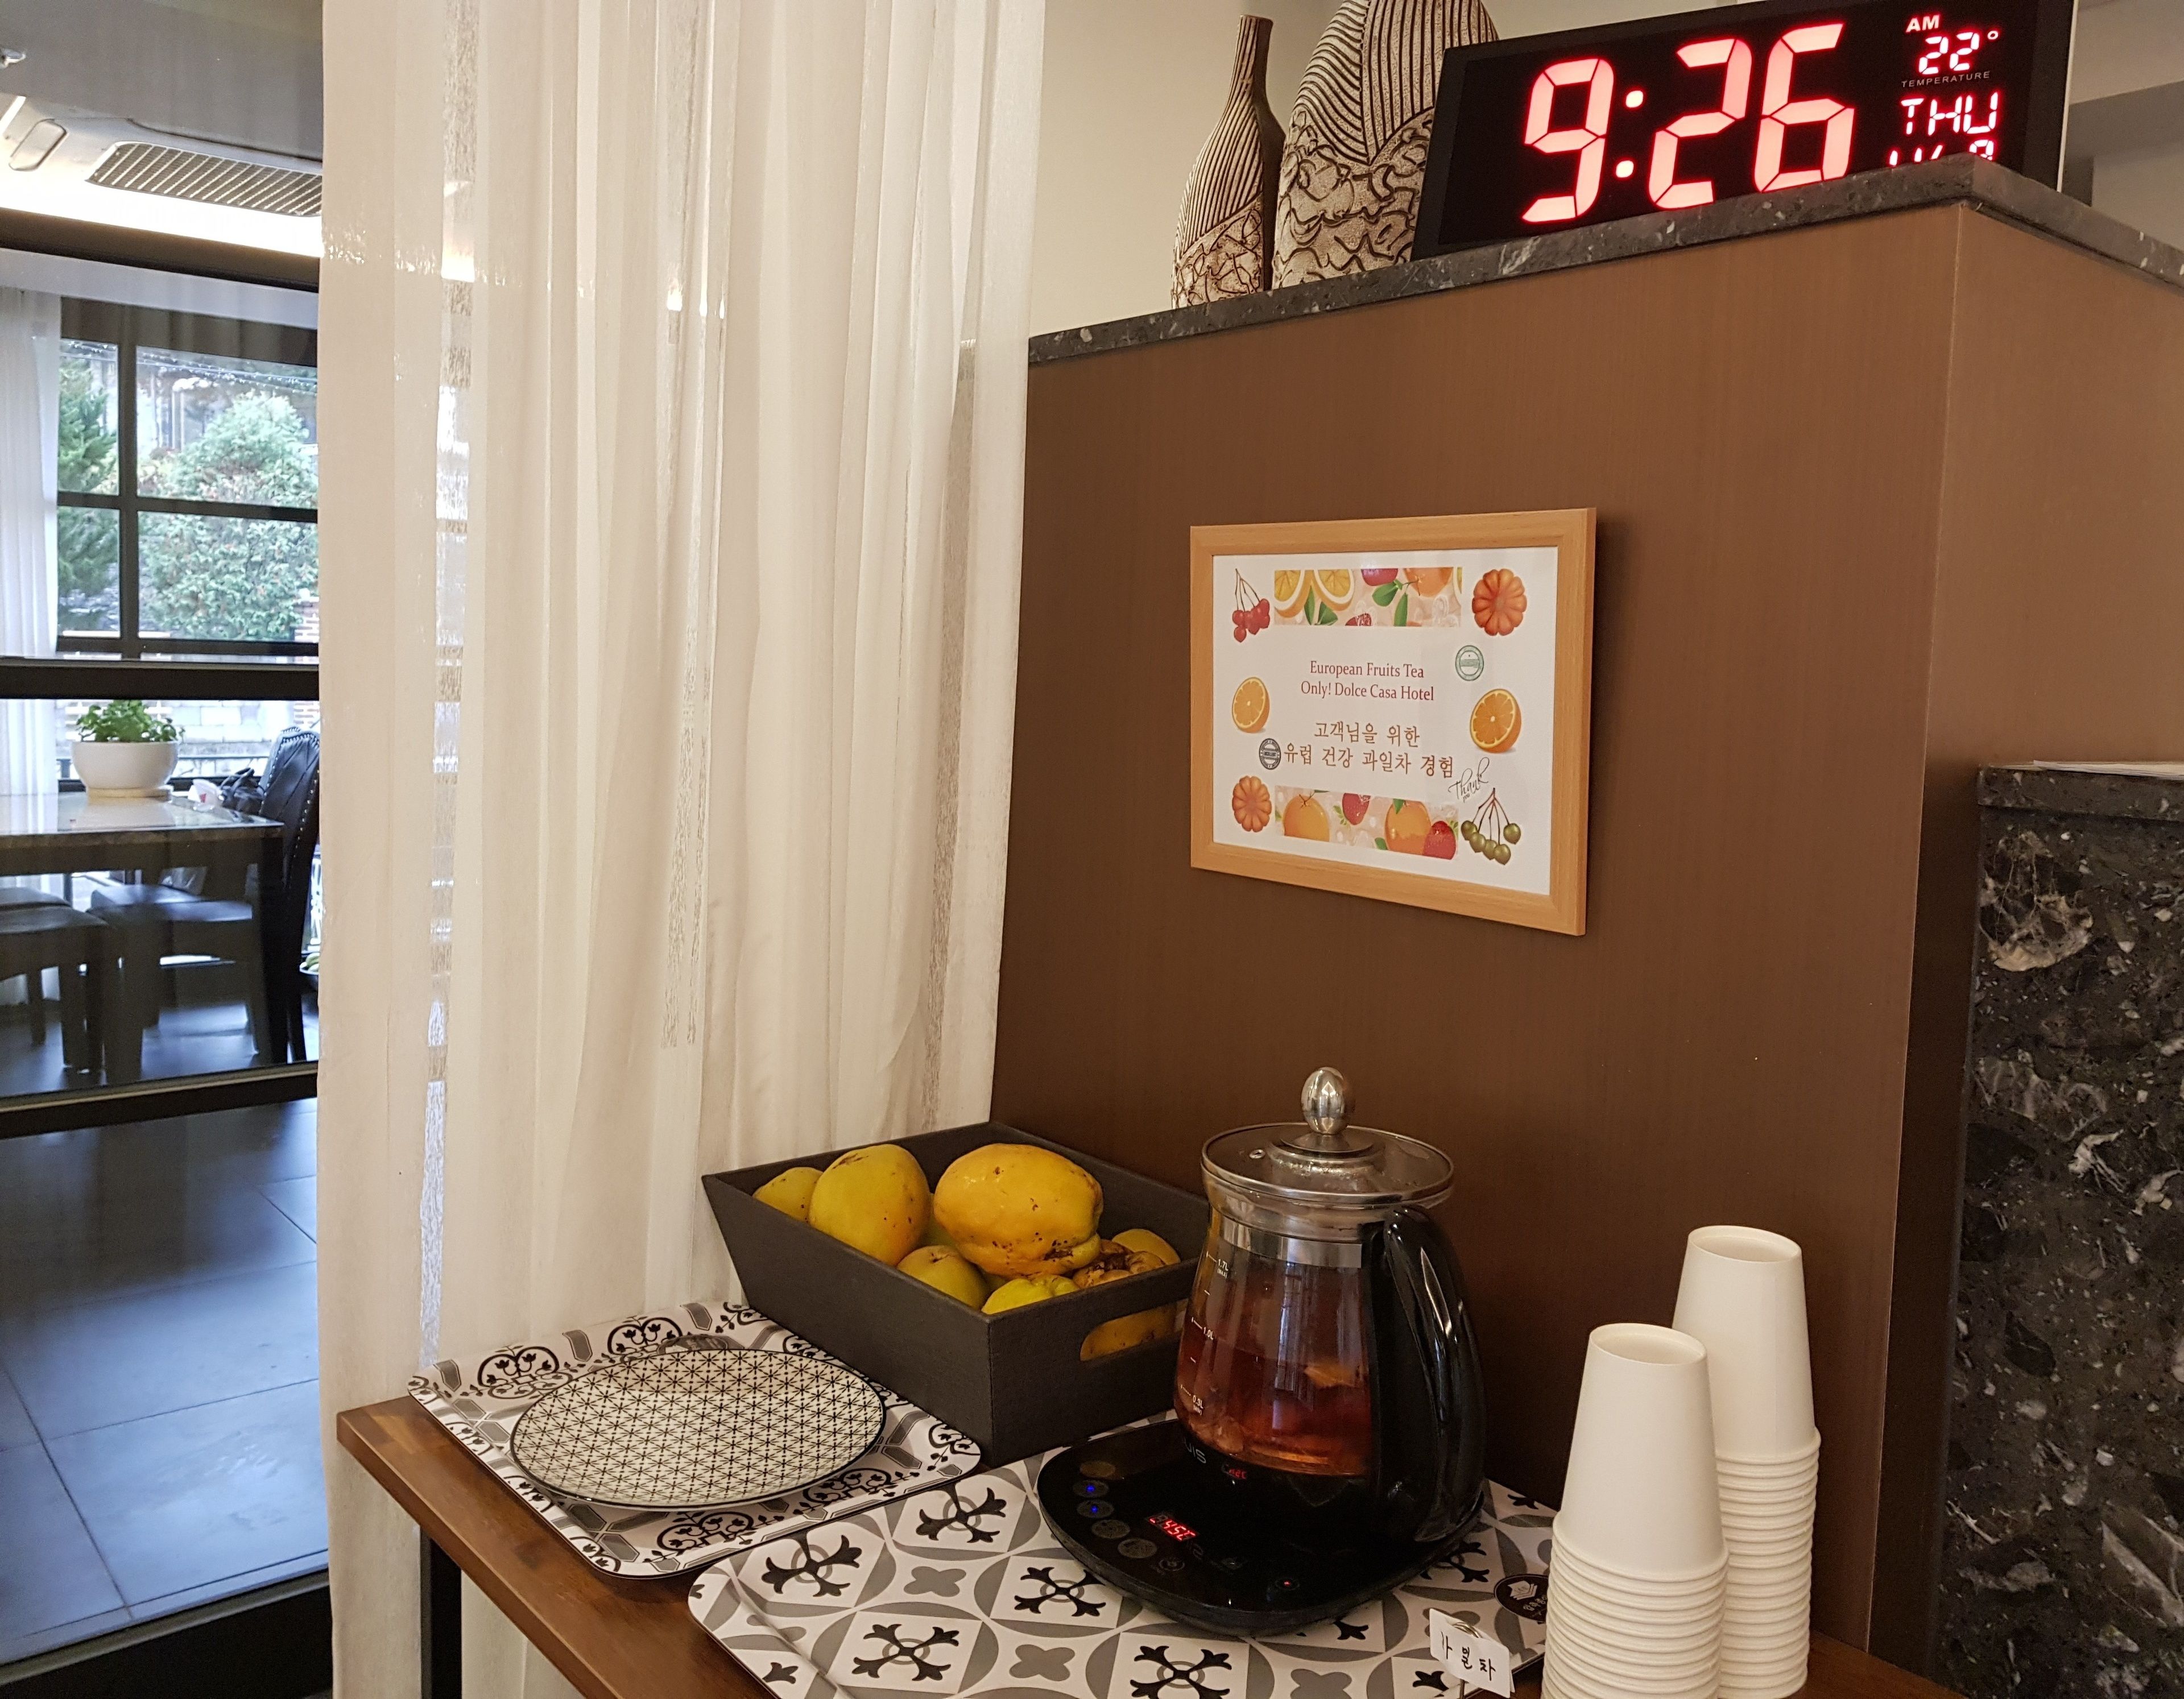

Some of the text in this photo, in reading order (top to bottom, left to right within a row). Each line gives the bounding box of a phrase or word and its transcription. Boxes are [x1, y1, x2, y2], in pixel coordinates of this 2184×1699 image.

[1906, 14, 1941, 33] AM
[1901, 71, 1991, 88] TEMPERATURE
[1522, 23, 1855, 223] 9:26
[1900, 92, 1999, 136] THU
[1310, 660, 1424, 678] European Fruits Tea
[1301, 681, 1434, 701] Only! Dolce Casa Hotel
[1314, 720, 1420, 748] 고객님을 위한
[1284, 742, 1312, 765] 유럽
[1322, 746, 1354, 768] 건강
[1362, 749, 1412, 775] 과일차
[1420, 755, 1454, 778] 경험
[1203, 1326, 1214, 1341] 1.0L
